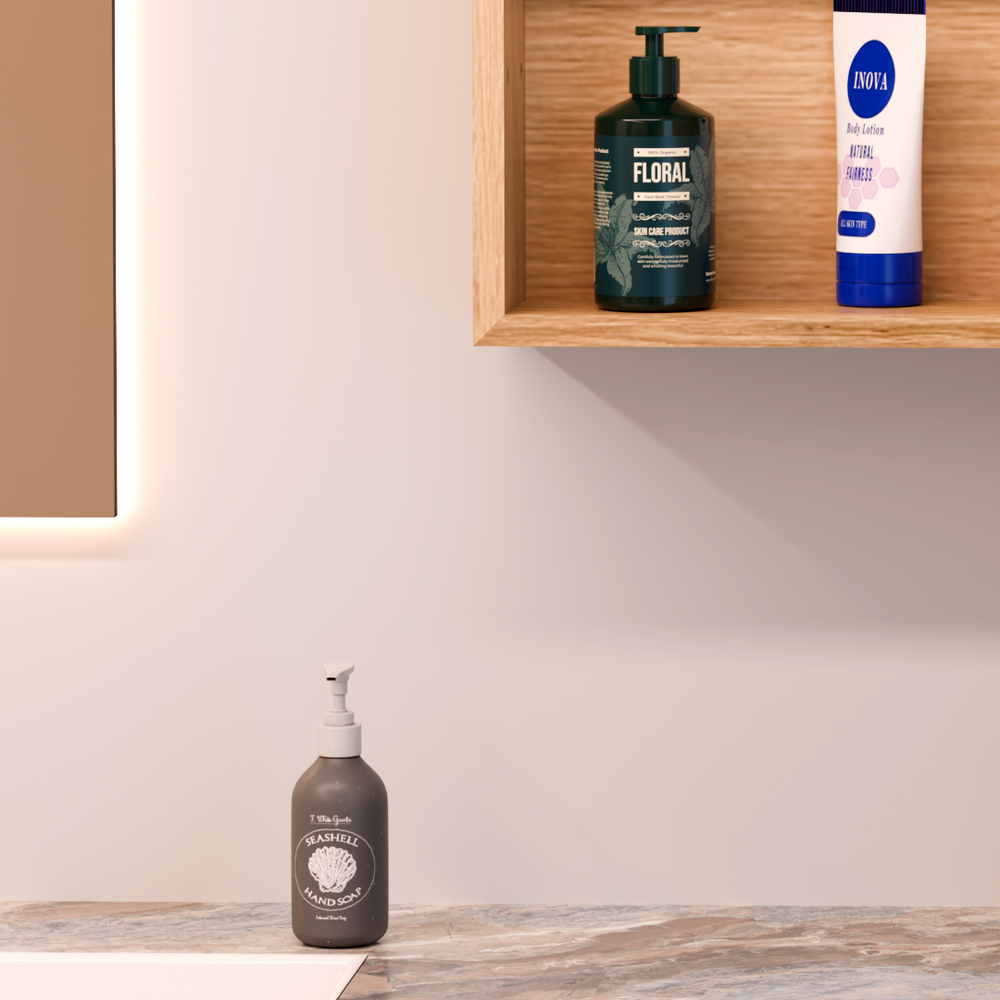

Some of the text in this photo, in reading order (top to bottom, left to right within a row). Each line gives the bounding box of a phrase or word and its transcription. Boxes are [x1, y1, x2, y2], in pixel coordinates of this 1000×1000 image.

[853, 71, 888, 90] INOVA
[847, 122, 884, 137] Body Lotion
[850, 144, 874, 159] NATURAL
[634, 162, 690, 183] FLORAL
[846, 166, 873, 181] FAIRNESS
[634, 227, 689, 236] SKIN CARE PRODUCT
[305, 833, 359, 847] SEASHELL
[304, 887, 361, 906] HAND SOAP
